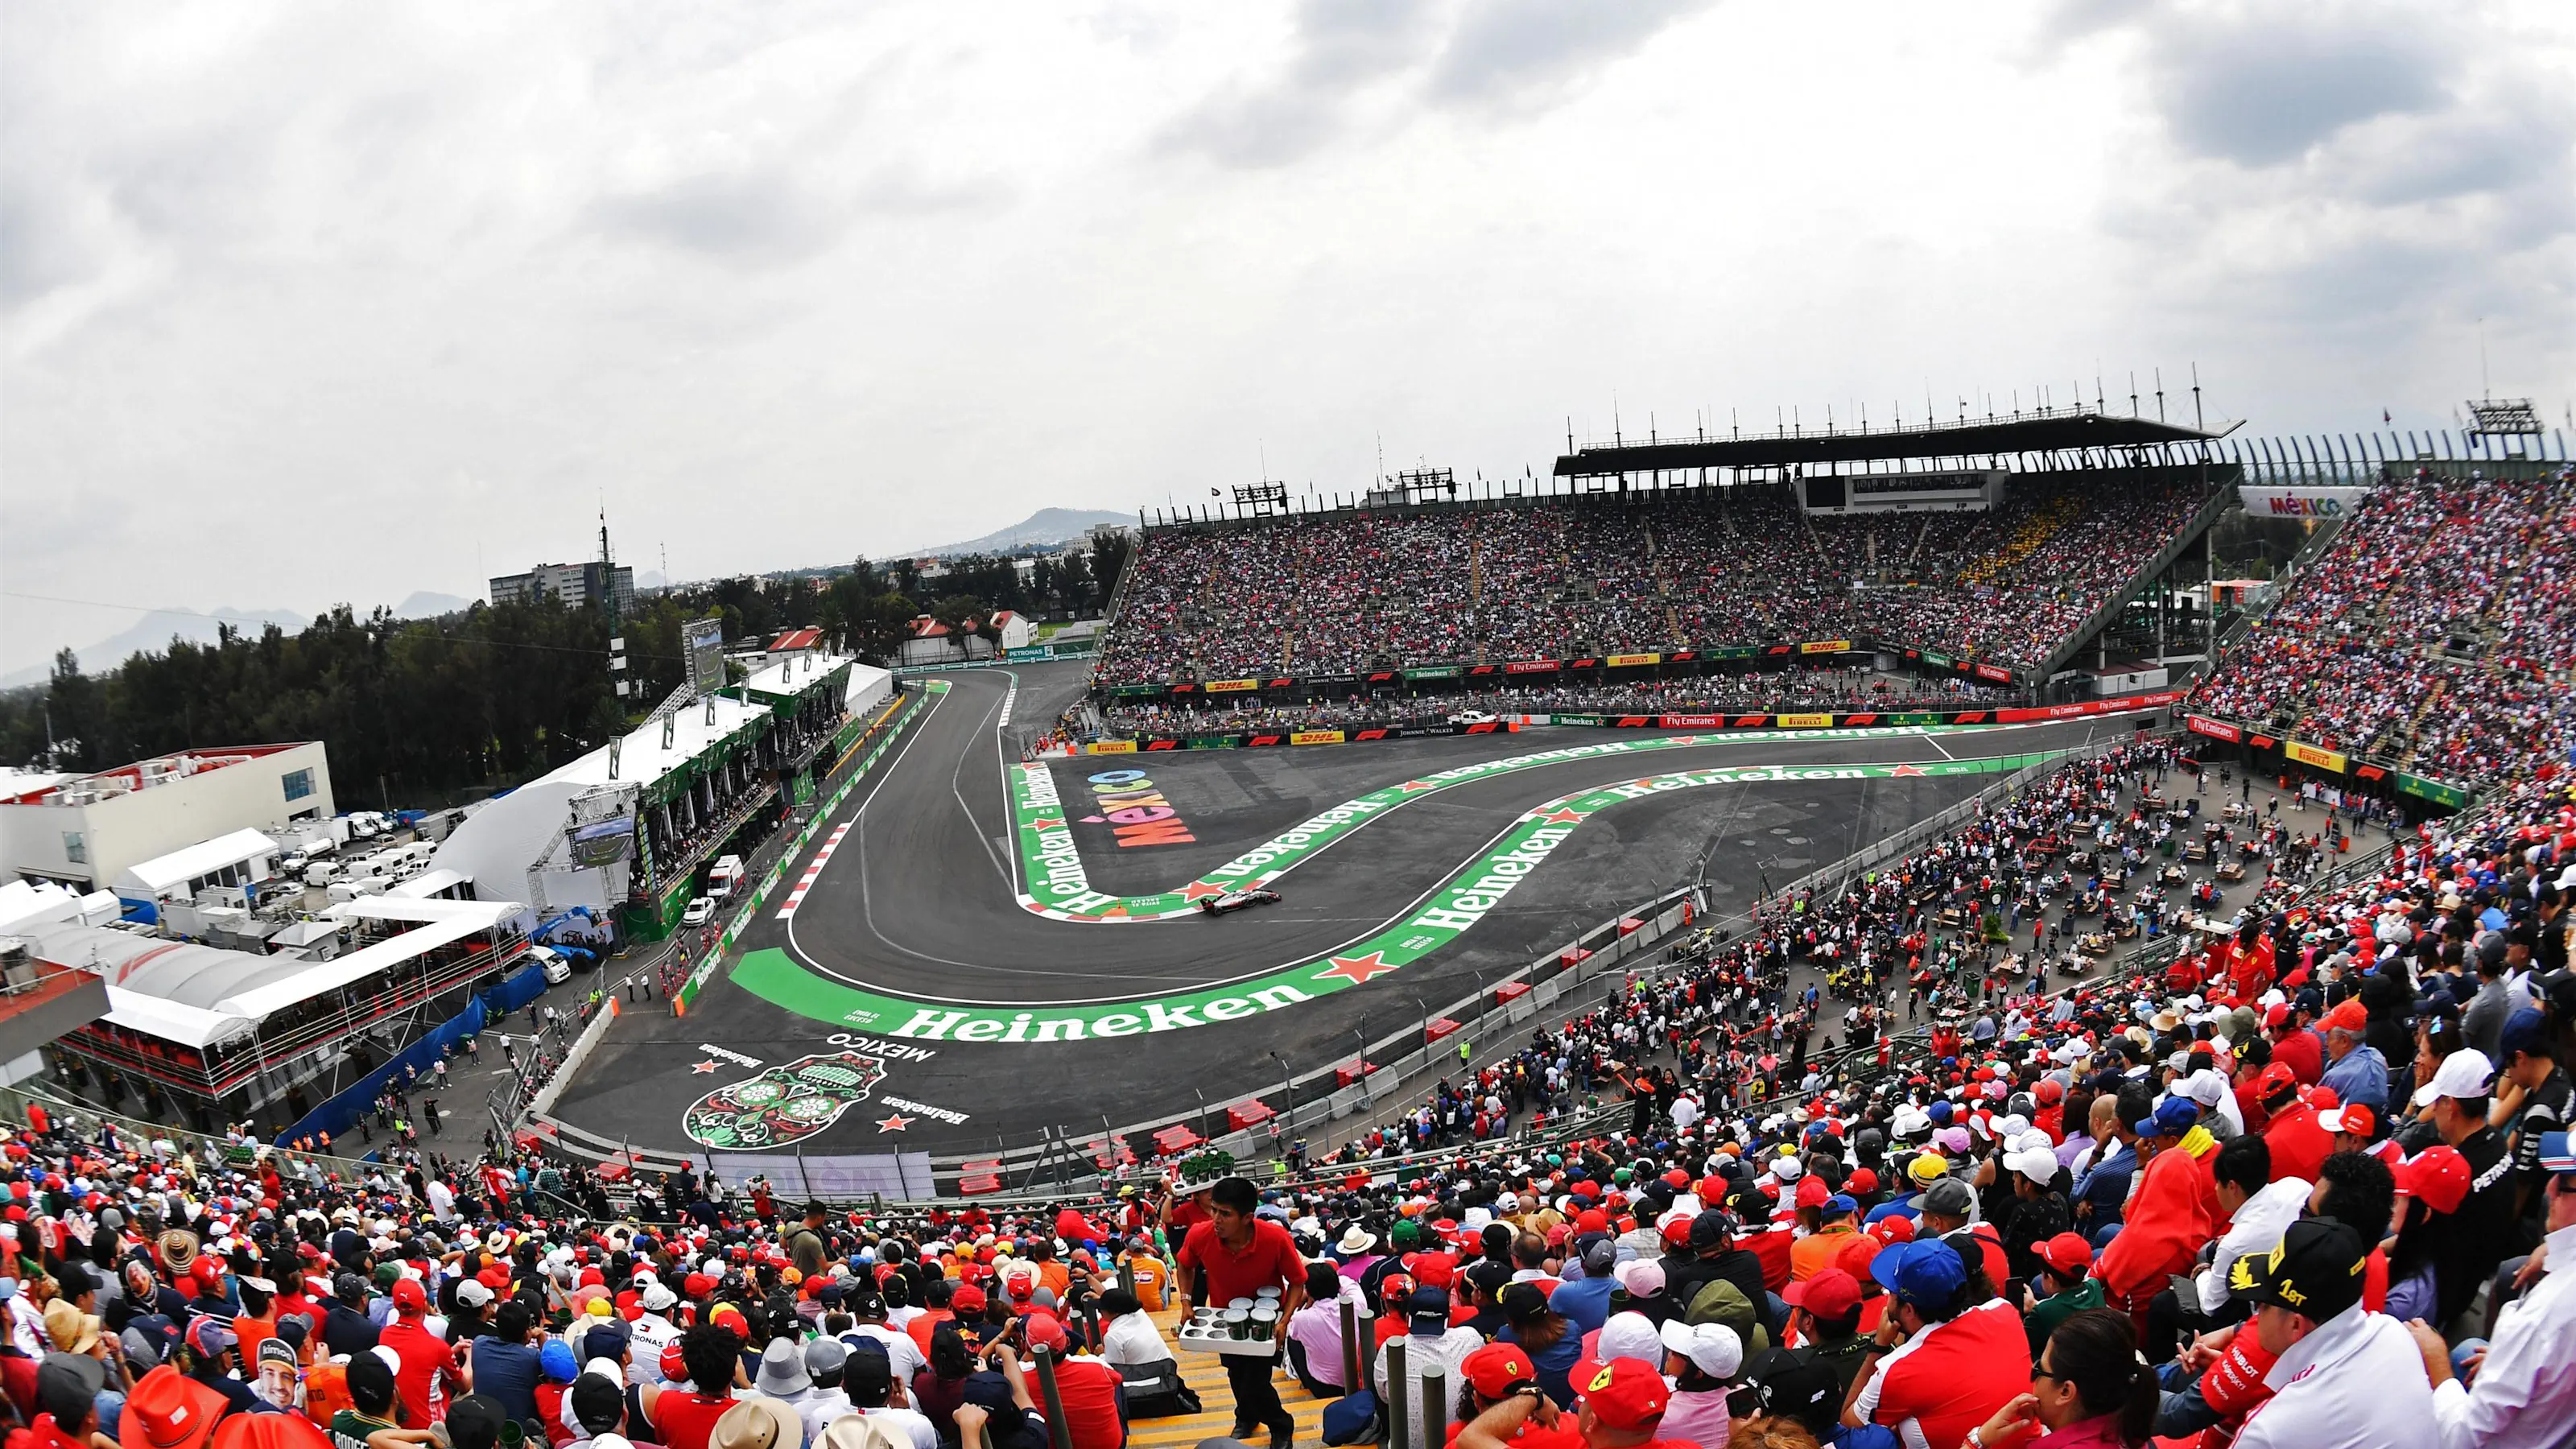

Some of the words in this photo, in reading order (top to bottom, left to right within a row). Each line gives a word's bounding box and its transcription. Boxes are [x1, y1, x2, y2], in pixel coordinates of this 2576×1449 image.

[1009, 649, 1043, 657] PETRONAS
[1810, 643, 1839, 651] DHL
[1620, 655, 1649, 664] PIRELLI
[1513, 663, 1525, 672] Fly
[1525, 661, 1554, 671] Emirates
[1415, 670, 1448, 679] Heineken
[1214, 682, 1246, 690] DHL
[2099, 701, 2108, 710] Fly
[2109, 700, 2131, 708] Emirates
[2145, 696, 2153, 704] Fly
[2153, 694, 2174, 703] Emirates
[2050, 708, 2060, 716] Fly
[2061, 706, 2083, 715] Emirates
[1561, 716, 1595, 726] Heineken
[1667, 716, 1680, 726] Fly
[1681, 716, 1715, 725] Emirates
[1789, 717, 1822, 725] PIRELLI
[1429, 727, 1454, 735] WALKER
[1713, 725, 1930, 740] Heineken
[2194, 720, 2205, 730] Fly
[2205, 723, 2233, 738] Emirates
[1300, 733, 1335, 742] DHL
[1096, 743, 1127, 752] PIRELLI
[1428, 741, 1634, 779] Heineken
[2298, 748, 2330, 766] PIRELLI
[1604, 767, 1868, 799] Heineken
[1210, 799, 1389, 877] Heineken
[1032, 829, 1121, 914] Heineken
[1411, 828, 1573, 932] Heineken
[730, 910, 752, 943] Heineken
[695, 952, 721, 990] Heineken
[887, 982, 1316, 1043] Heineken
[827, 1033, 936, 1063] MEXICO
[698, 1043, 764, 1069] Heineken
[881, 1096, 971, 1126] Heineken
[2231, 1346, 2259, 1378] HUBLOT
